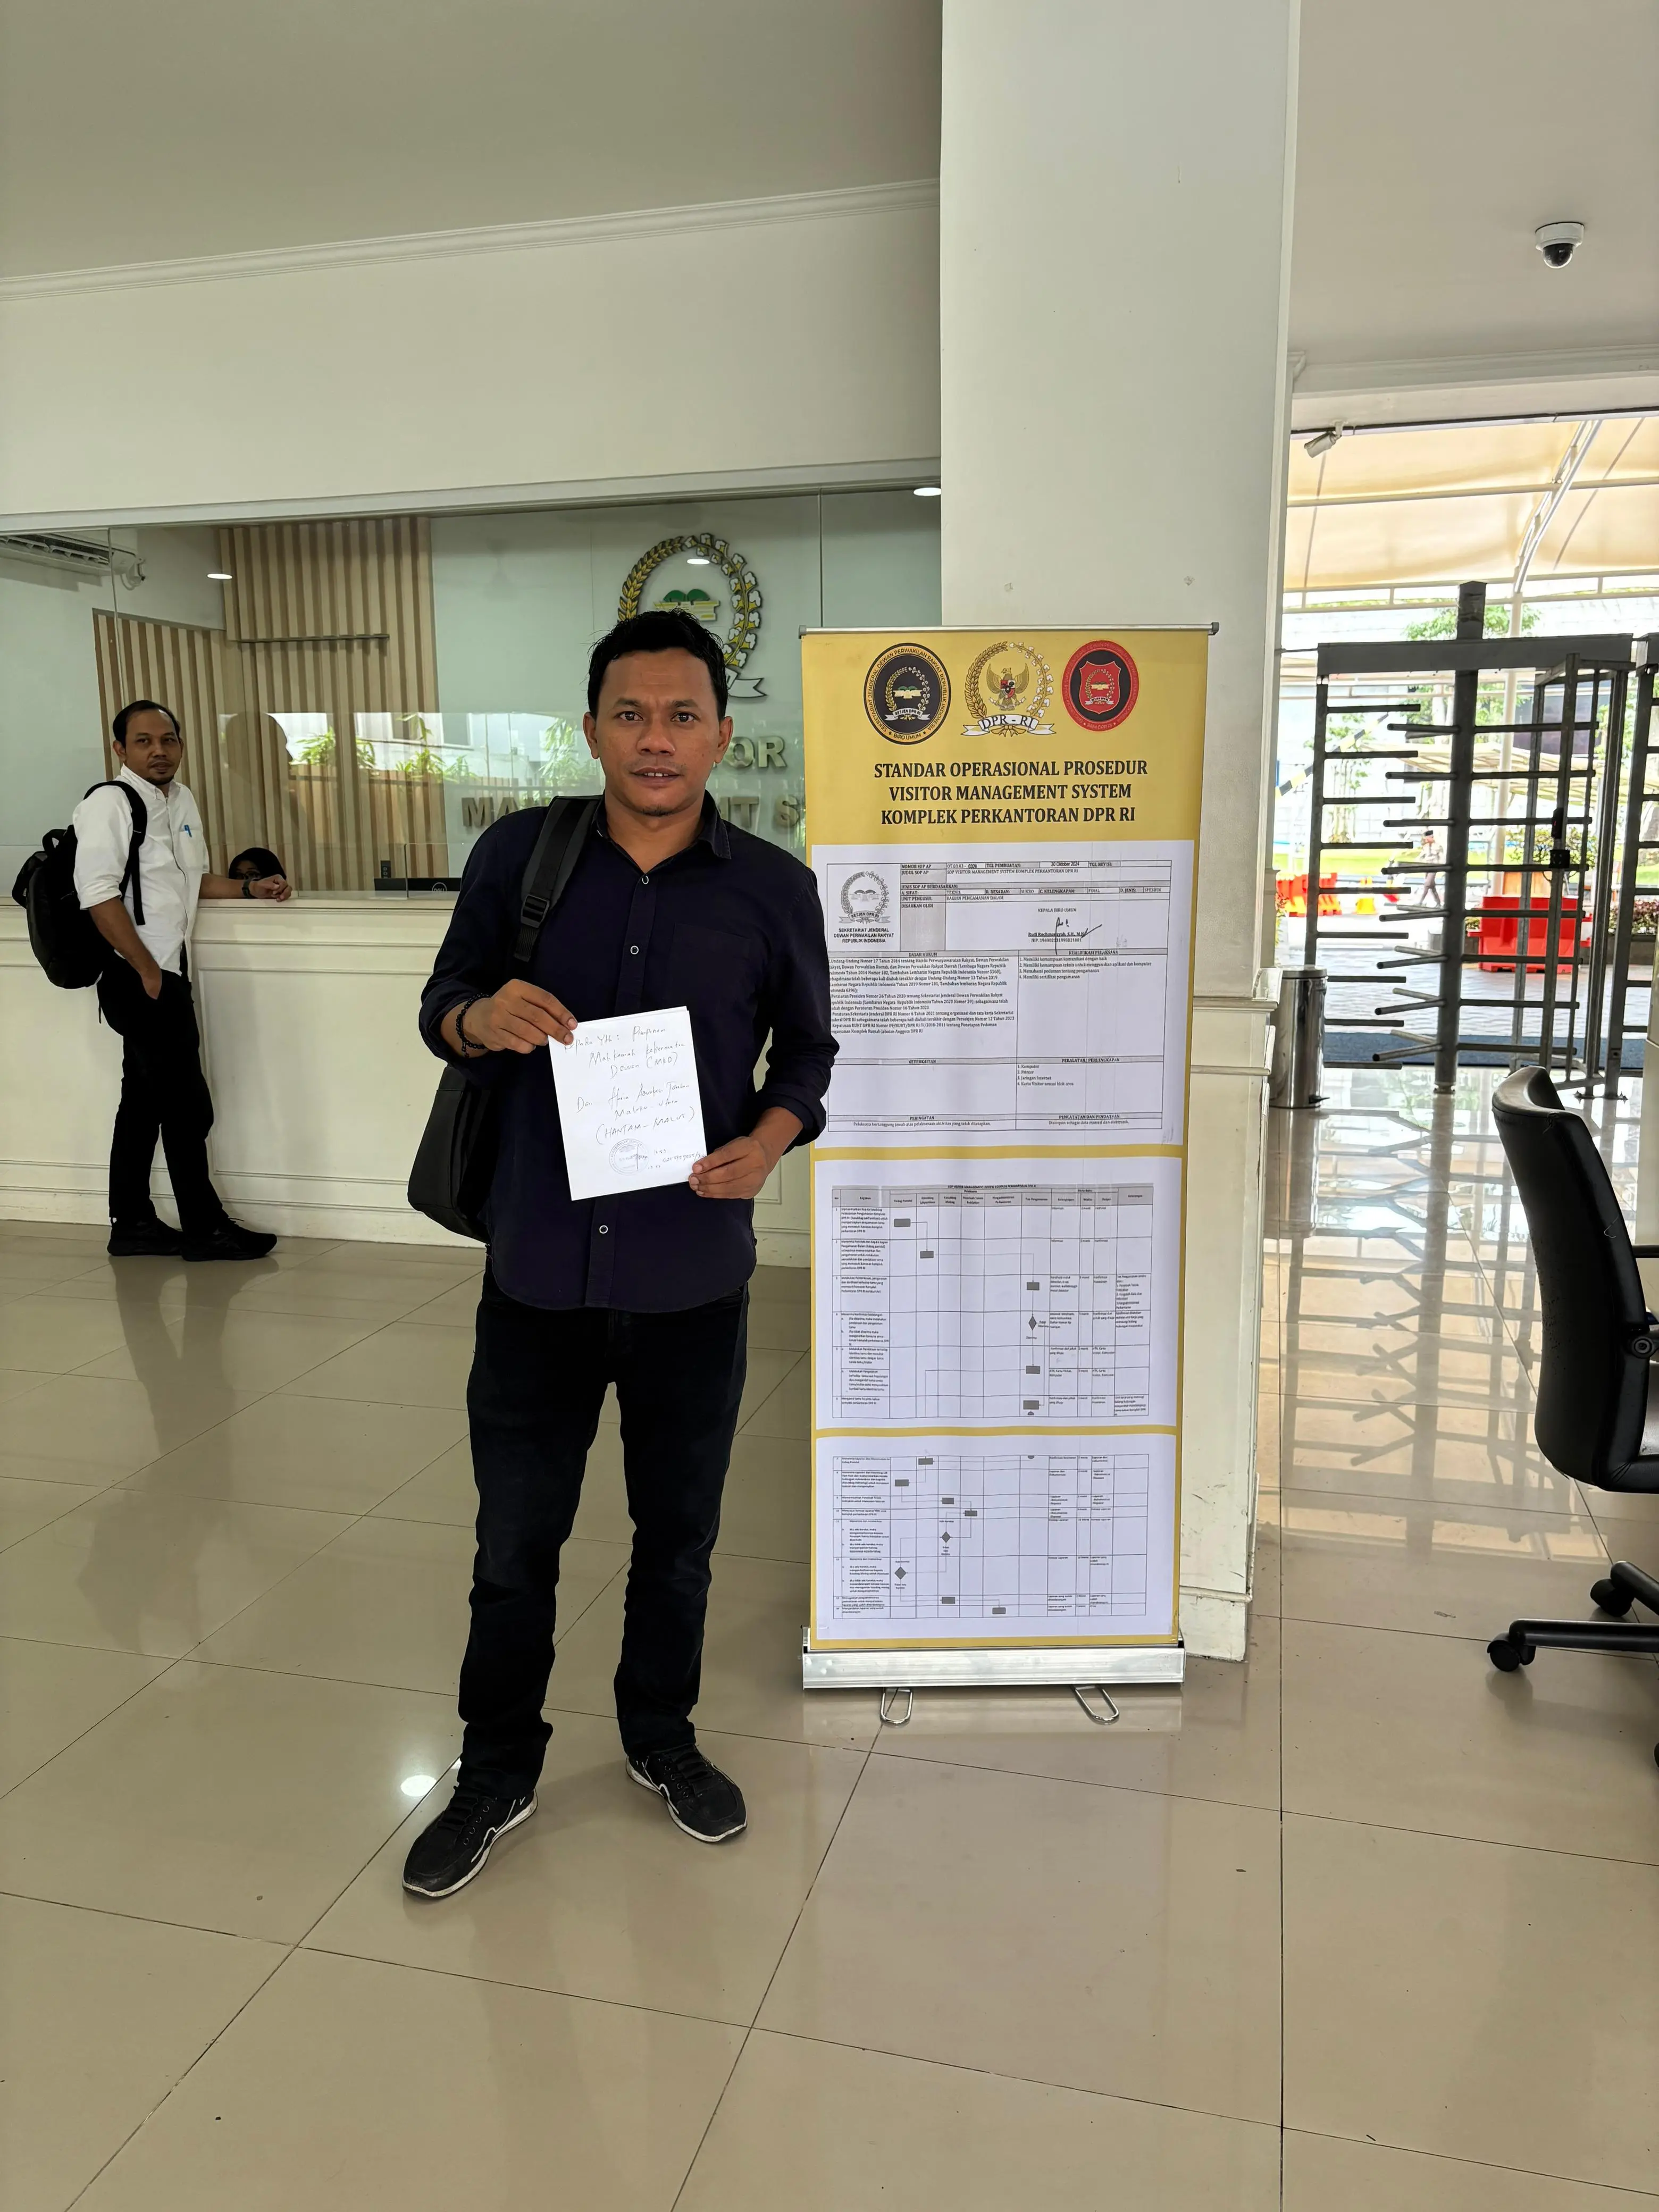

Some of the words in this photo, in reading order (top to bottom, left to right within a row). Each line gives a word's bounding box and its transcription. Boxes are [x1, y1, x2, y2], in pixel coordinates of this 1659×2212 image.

[877, 652, 894, 669] DEWAN
[894, 648, 927, 658] PERWAKILAN
[927, 655, 942, 674] RAKYAT
[868, 669, 879, 699] JENDERAL
[868, 696, 888, 732] SEKRETARIAT
[928, 706, 946, 731] INDONESIA
[981, 715, 1007, 730] DPR
[1020, 716, 1034, 730] RI
[874, 763, 946, 778] STANDAR
[950, 761, 1060, 777] OPERASIONAL
[1063, 760, 1148, 775] PROSEDUR
[889, 786, 952, 801] VISITOR
[956, 784, 1068, 800] MANAGEMENT
[1071, 784, 1132, 799] SYSTEM
[881, 809, 958, 824] KOMPLEK
[961, 808, 1079, 824] PERKANTORAN
[1083, 807, 1116, 822] DPR
[1119, 807, 1135, 821] RI
